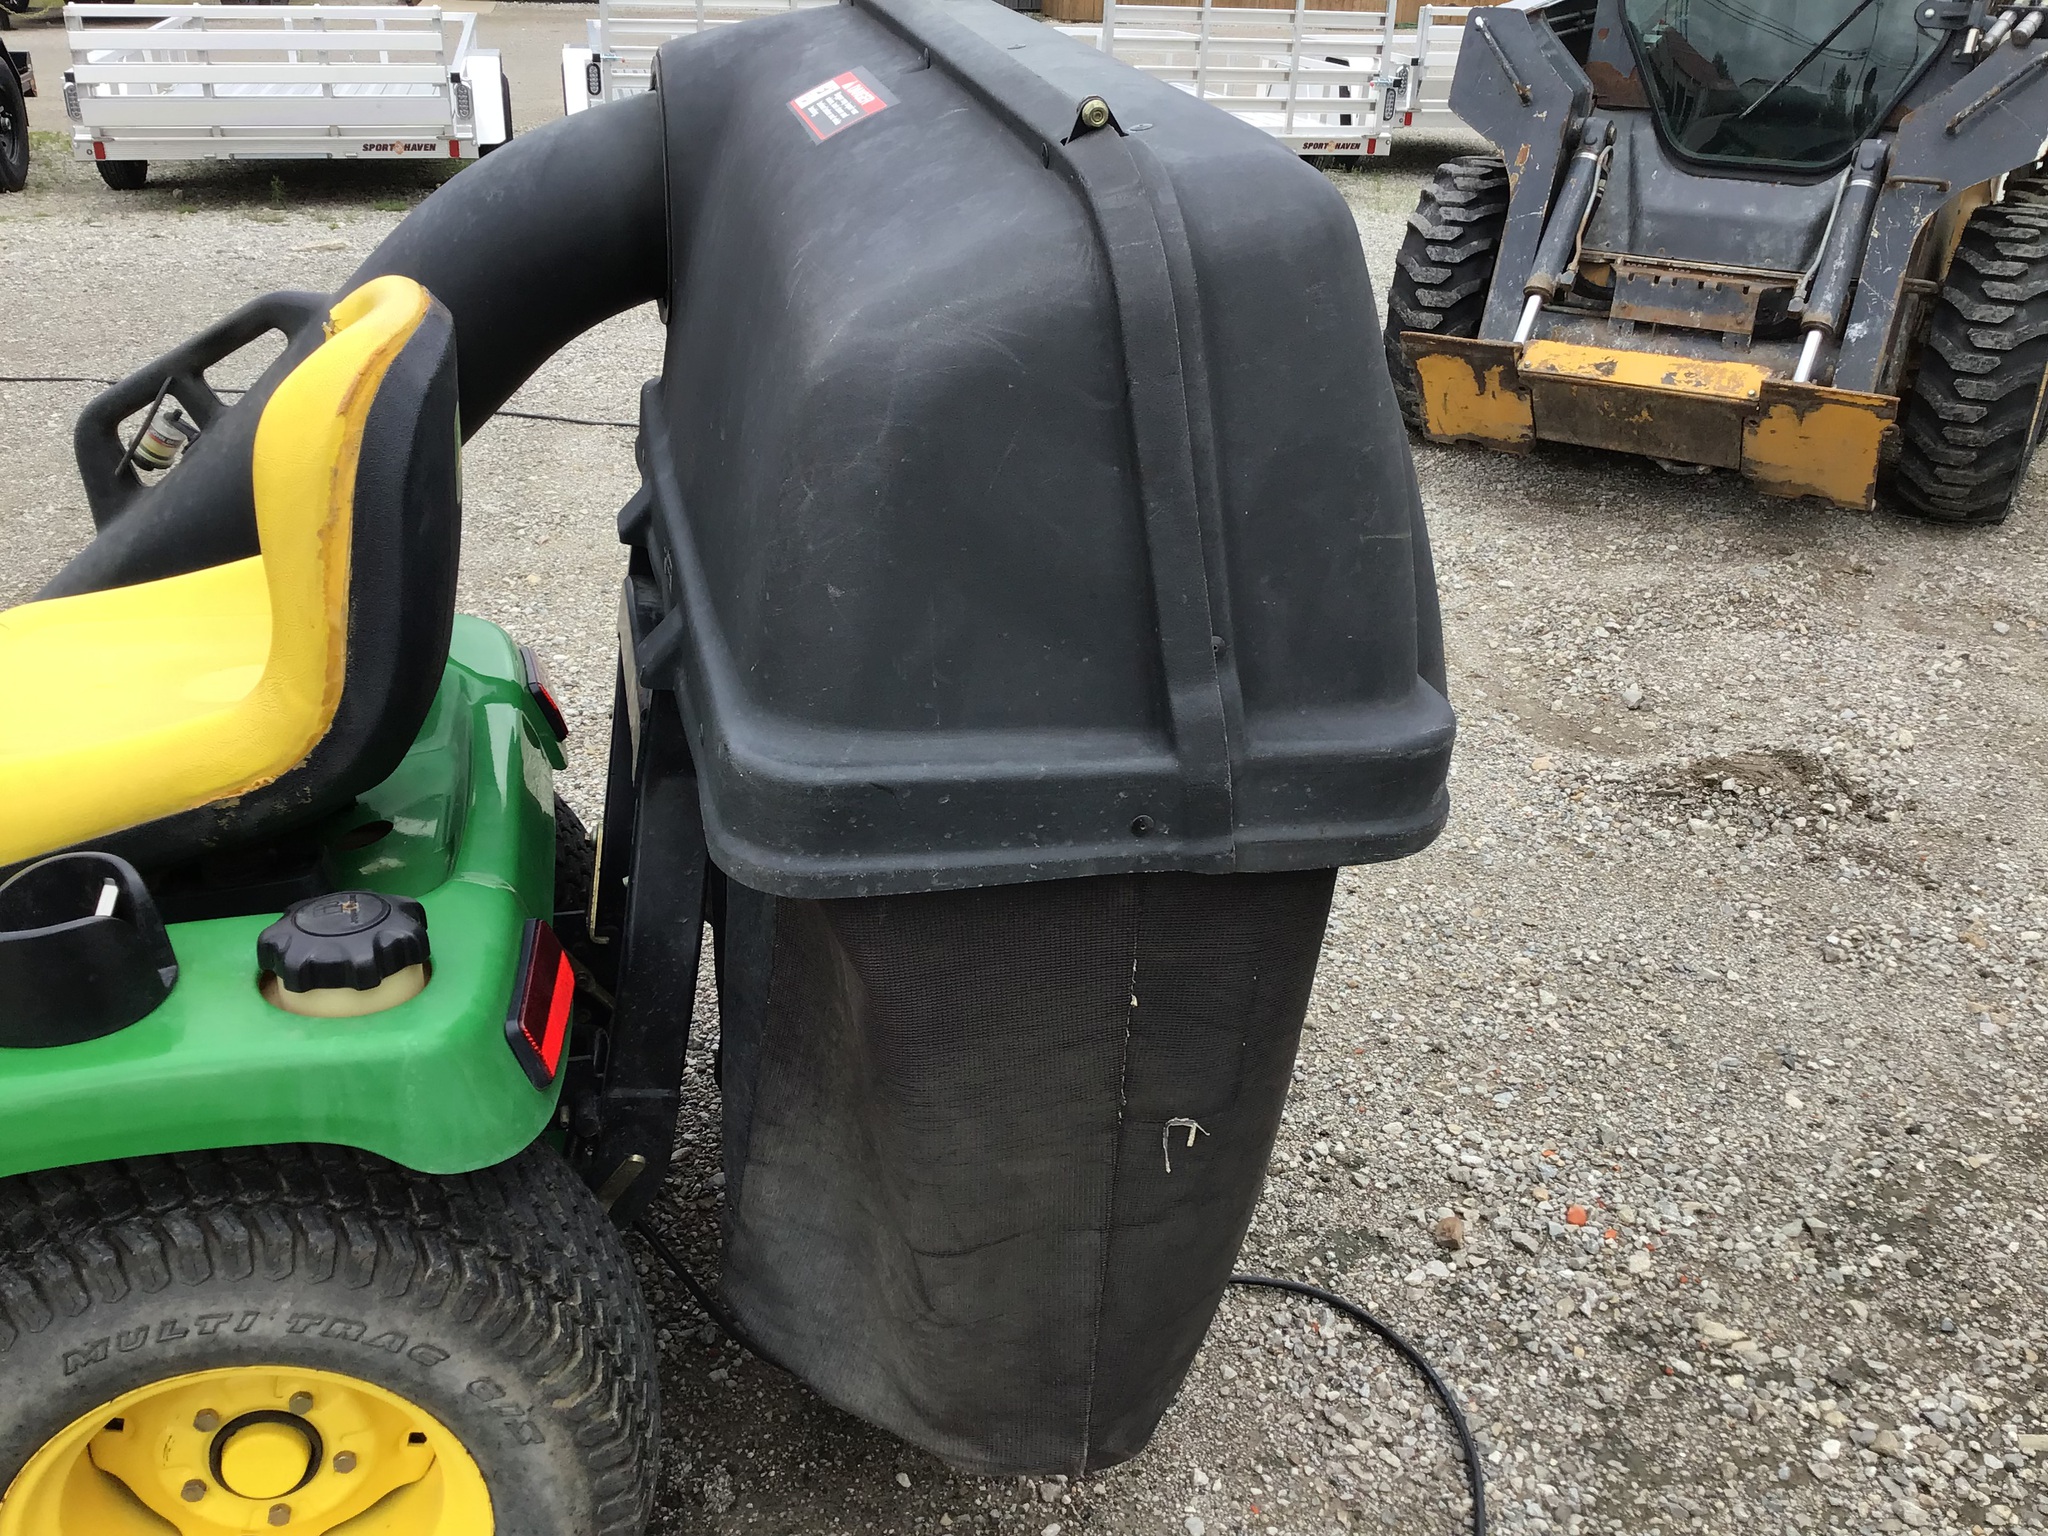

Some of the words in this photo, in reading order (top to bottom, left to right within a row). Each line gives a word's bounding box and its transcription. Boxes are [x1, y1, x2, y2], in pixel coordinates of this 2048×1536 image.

[362, 143, 394, 152] SPORT
[404, 143, 437, 152] HAVEN
[1302, 142, 1328, 150] SPORT
[1335, 142, 1361, 150] HAVEN
[62, 1310, 260, 1376] MULTI
[286, 1312, 447, 1366] TRAC
